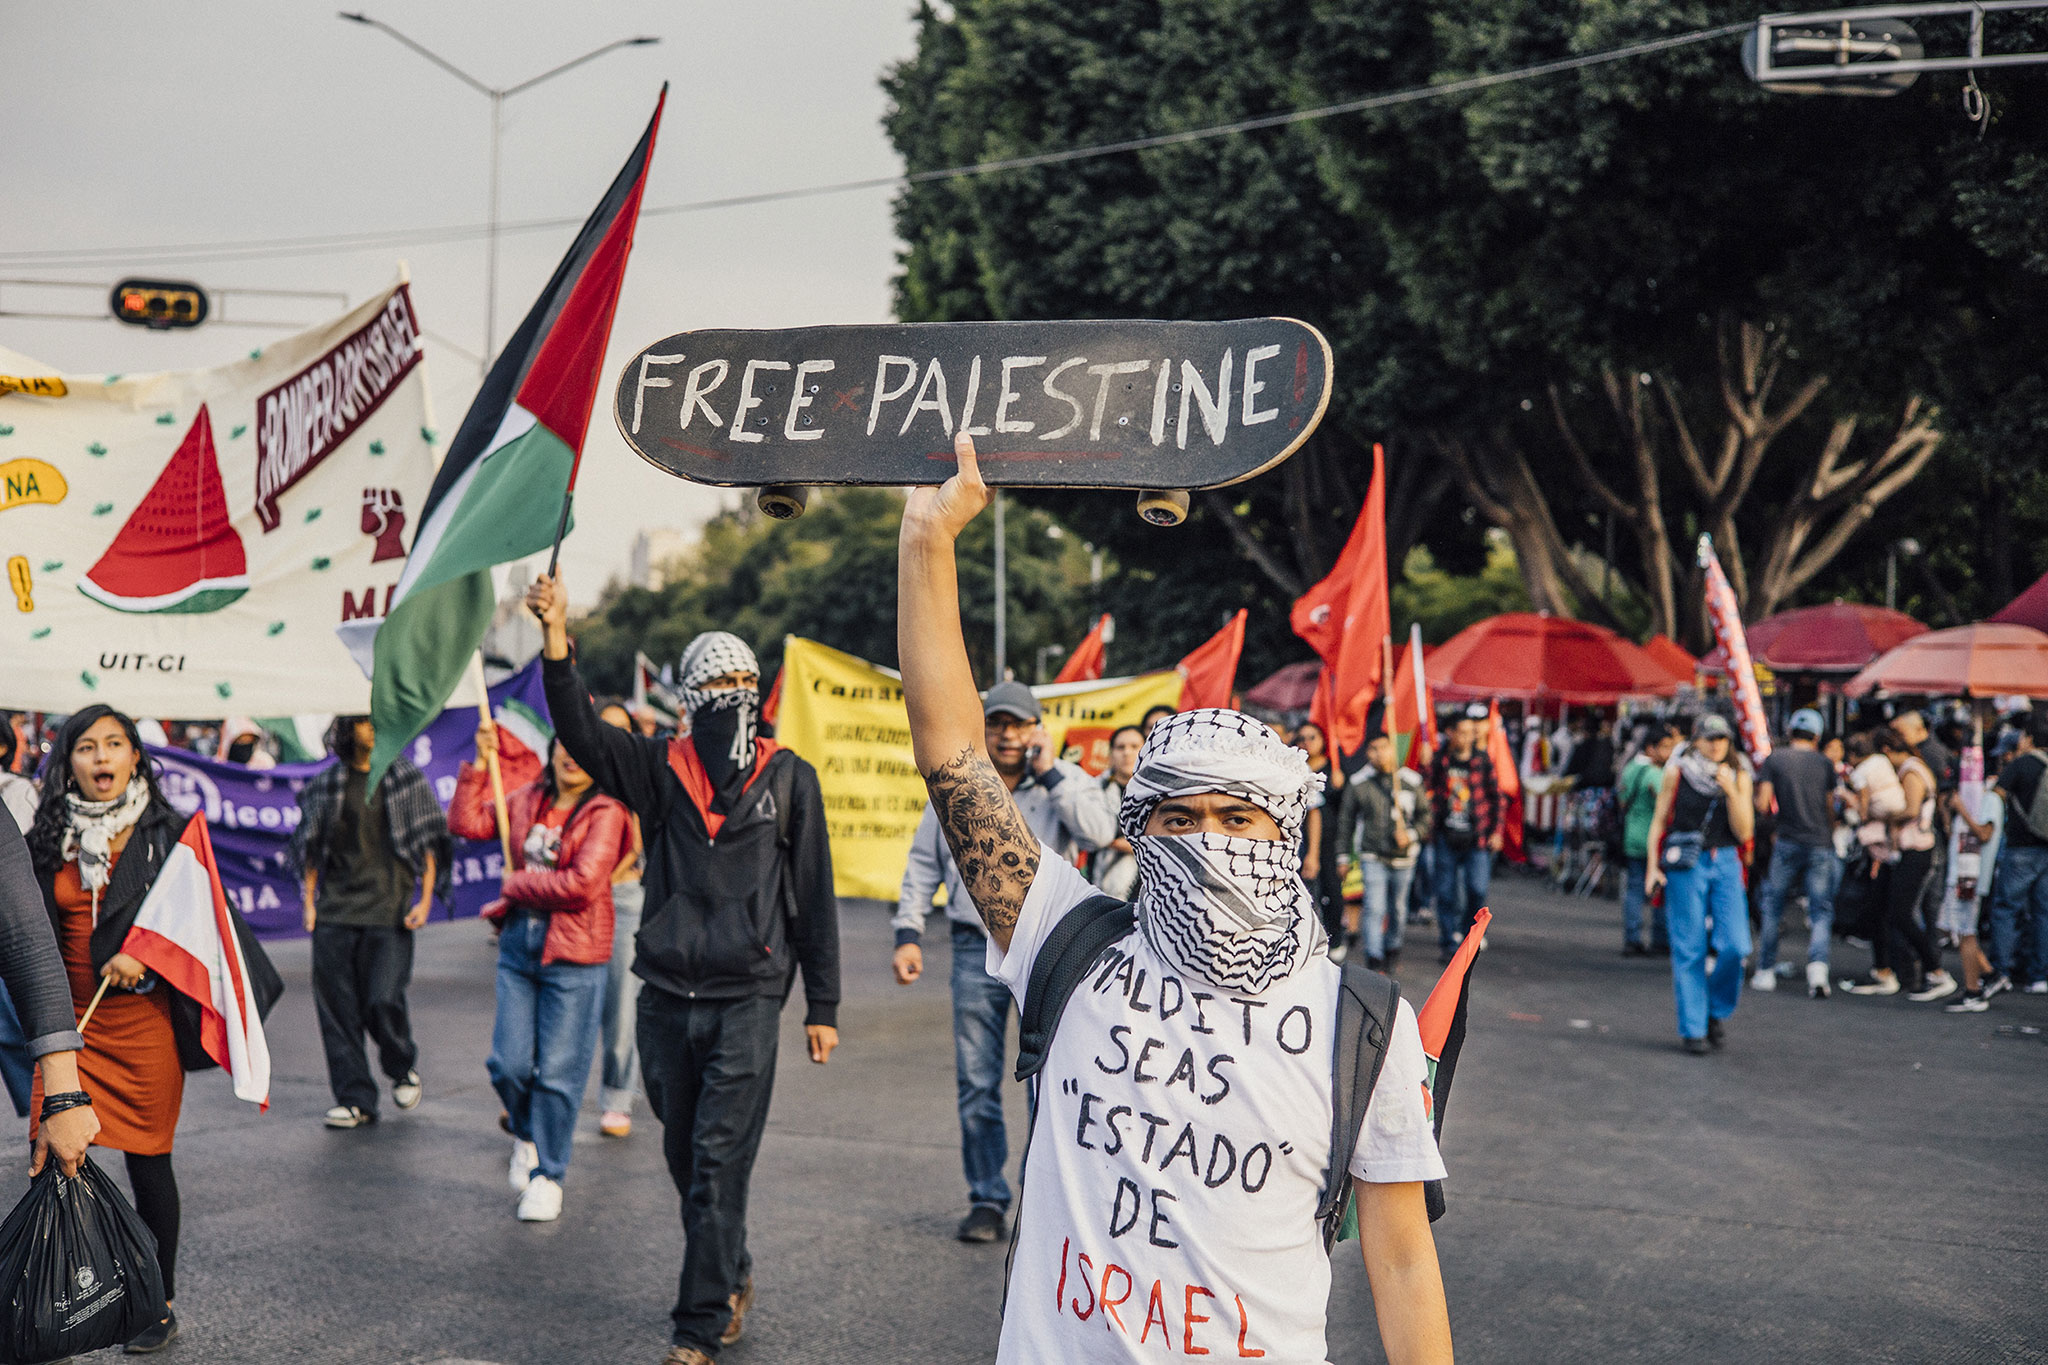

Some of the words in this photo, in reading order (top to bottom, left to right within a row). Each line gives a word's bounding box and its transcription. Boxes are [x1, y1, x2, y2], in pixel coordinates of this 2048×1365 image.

[630, 353, 836, 443] FREE
[100, 653, 185, 672] UIT-CI
[1080, 946, 1313, 1055] MALDITO
[1095, 1025, 1237, 1106] SEAS
[1063, 1078, 1294, 1193] "ESTADO"
[1109, 1177, 1180, 1249] DE
[1057, 1236, 1266, 1358] ISRAEL
